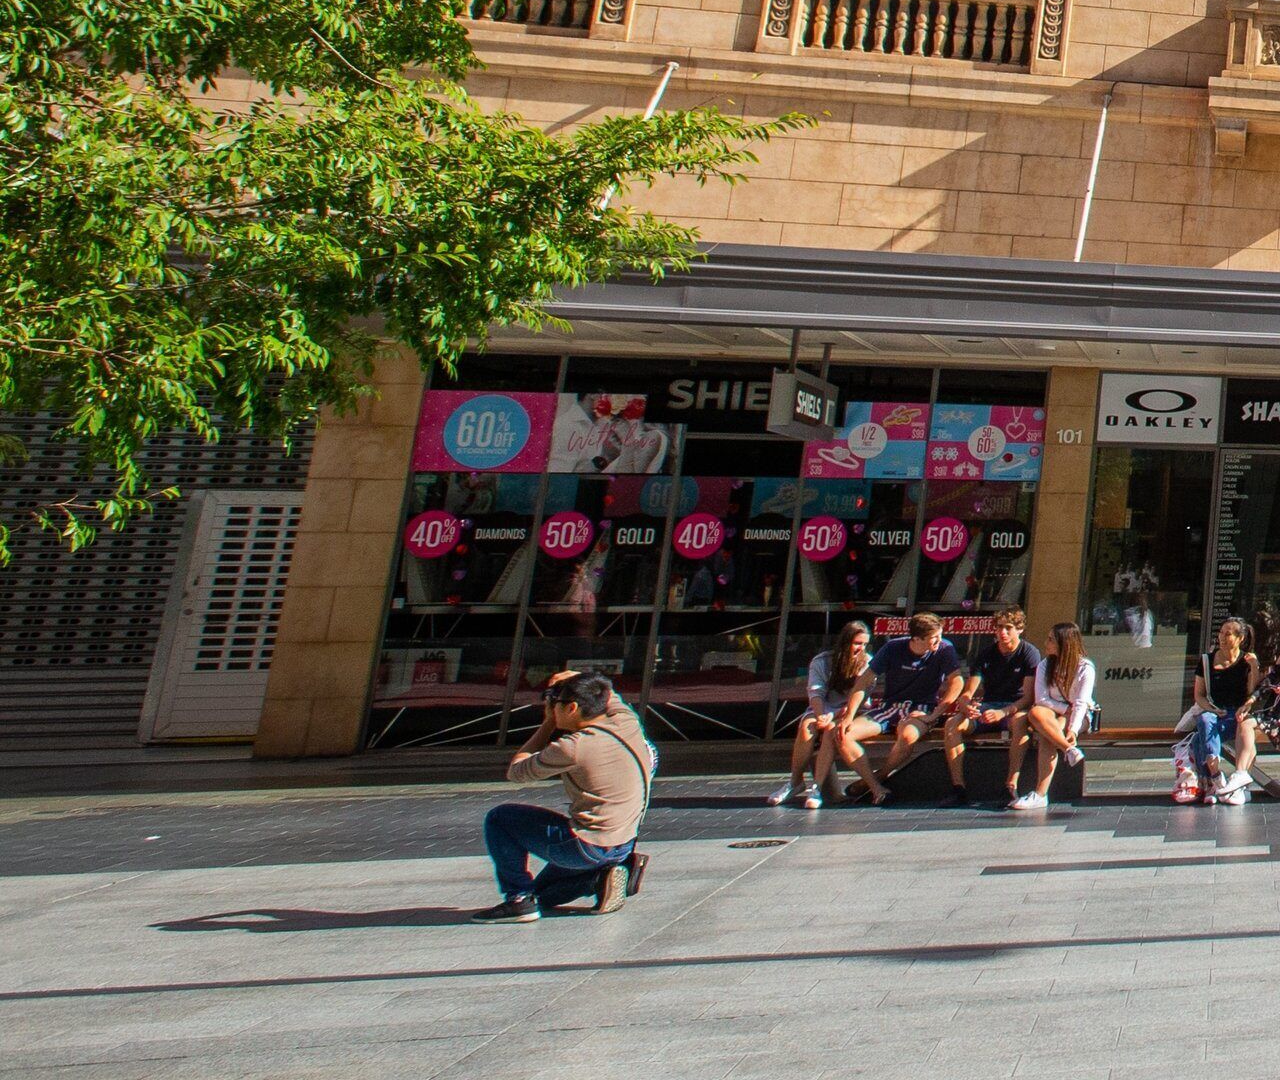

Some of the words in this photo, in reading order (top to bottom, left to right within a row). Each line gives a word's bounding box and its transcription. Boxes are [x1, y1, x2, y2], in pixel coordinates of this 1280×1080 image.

[667, 379, 770, 411] SHIE
[796, 389, 822, 420] SHIELS
[1105, 413, 1213, 430] OAKLEY
[493, 430, 515, 448] OFF
[569, 424, 616, 452] With
[622, 421, 658, 450] love
[860, 427, 877, 441] 1/2
[1056, 428, 1083, 444] 101
[977, 439, 991, 454] 60
[440, 532, 455, 544] OFF
[475, 527, 526, 541] DIAMONDS
[574, 534, 588, 544] OFF
[616, 527, 655, 546] GOLD
[706, 535, 719, 546] OFF
[744, 528, 791, 542] DIAMONDS
[868, 530, 911, 547] SILVER
[990, 532, 1025, 550] GOLD
[829, 537, 842, 548] OFF
[951, 538, 964, 549] OFF
[887, 620, 903, 631] 25%
[962, 620, 979, 630] 25%
[979, 620, 993, 631] OFF
[415, 672, 439, 683] JAG
[1104, 666, 1153, 681] SHADES
